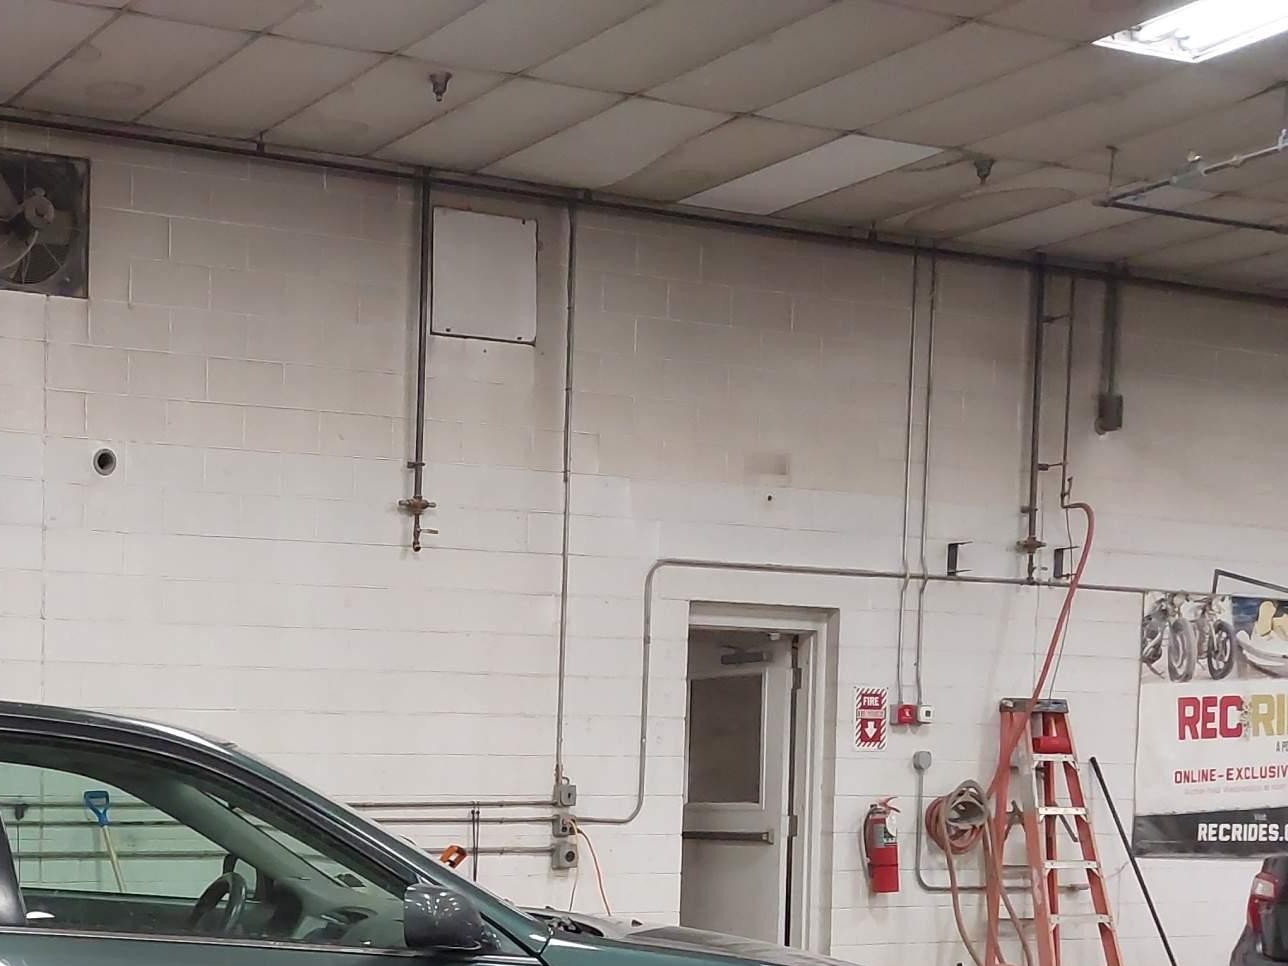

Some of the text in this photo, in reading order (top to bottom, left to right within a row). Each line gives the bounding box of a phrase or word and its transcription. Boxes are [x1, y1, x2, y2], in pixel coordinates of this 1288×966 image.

[863, 696, 880, 706] FIRE
[1178, 694, 1288, 739] REC RI
